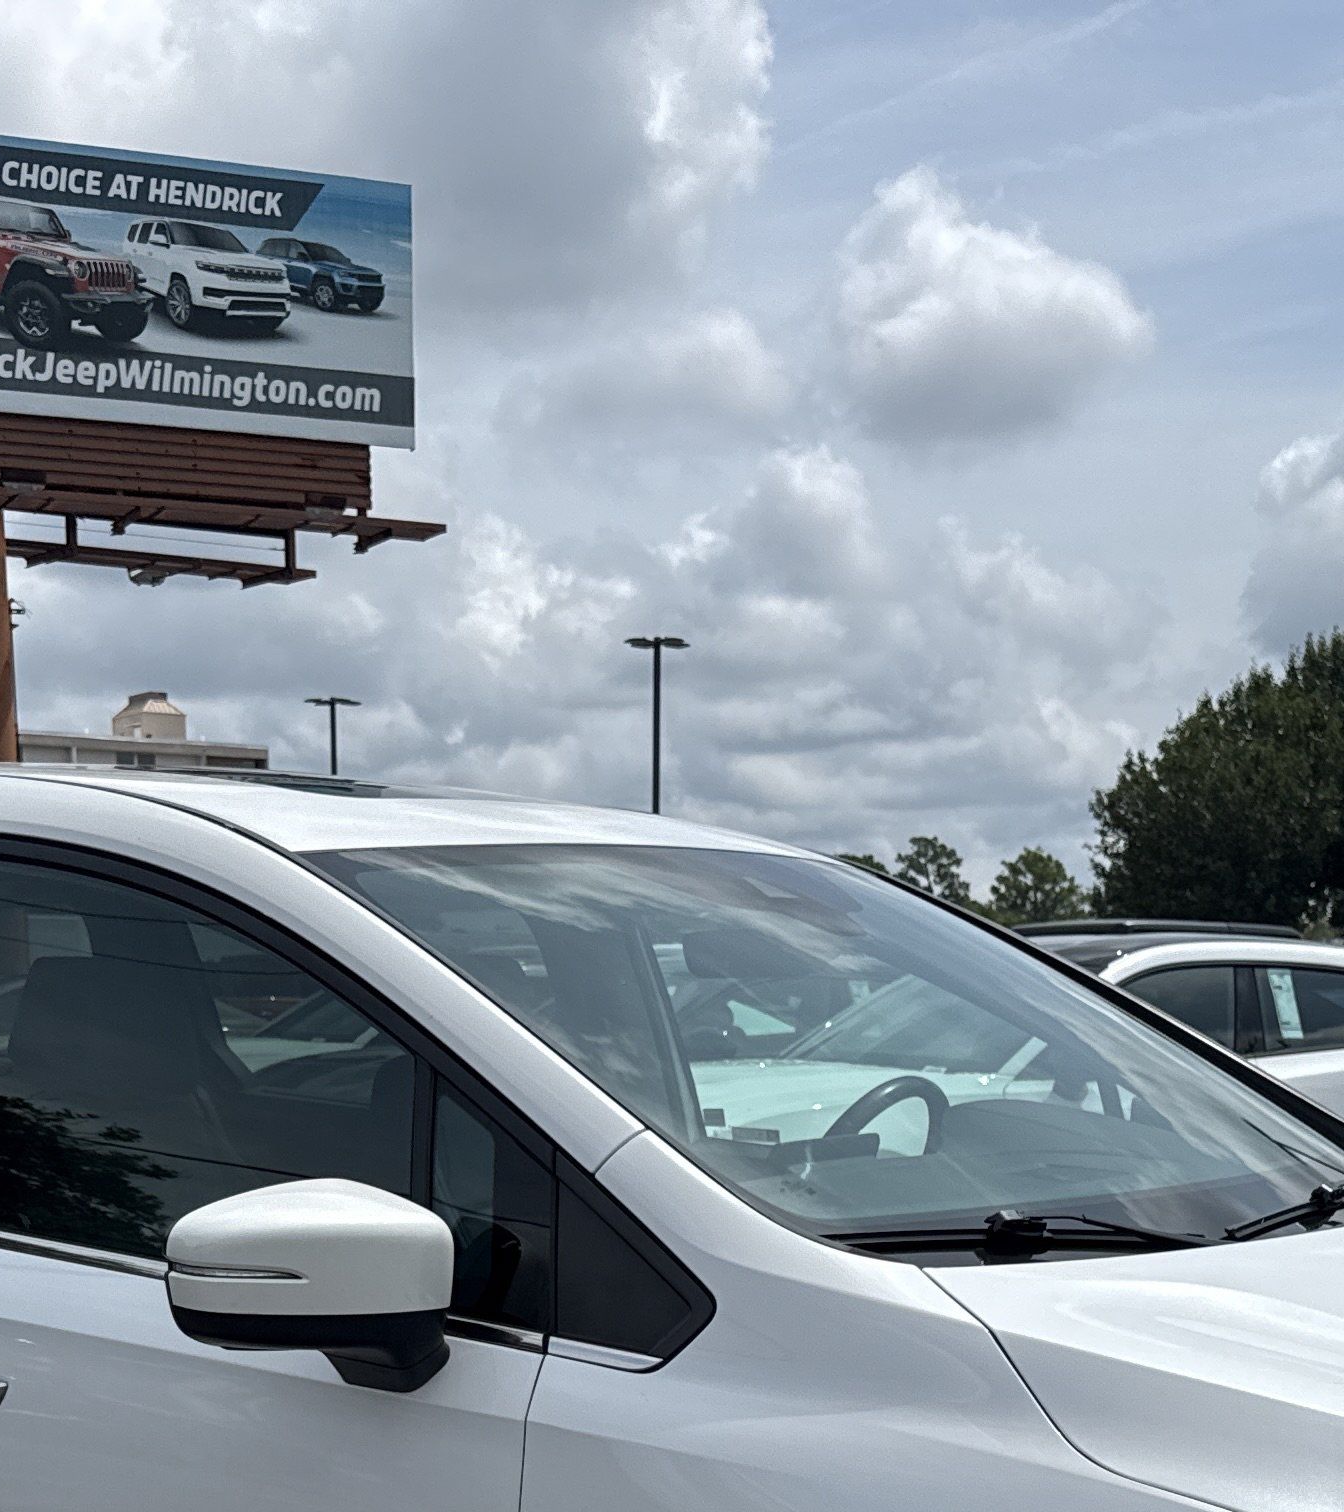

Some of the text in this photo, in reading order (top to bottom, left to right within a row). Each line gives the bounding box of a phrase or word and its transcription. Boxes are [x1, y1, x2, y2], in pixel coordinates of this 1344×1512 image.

[2, 162, 102, 196] CHOICE
[108, 173, 143, 201] AT
[149, 178, 283, 218] HENDRICK
